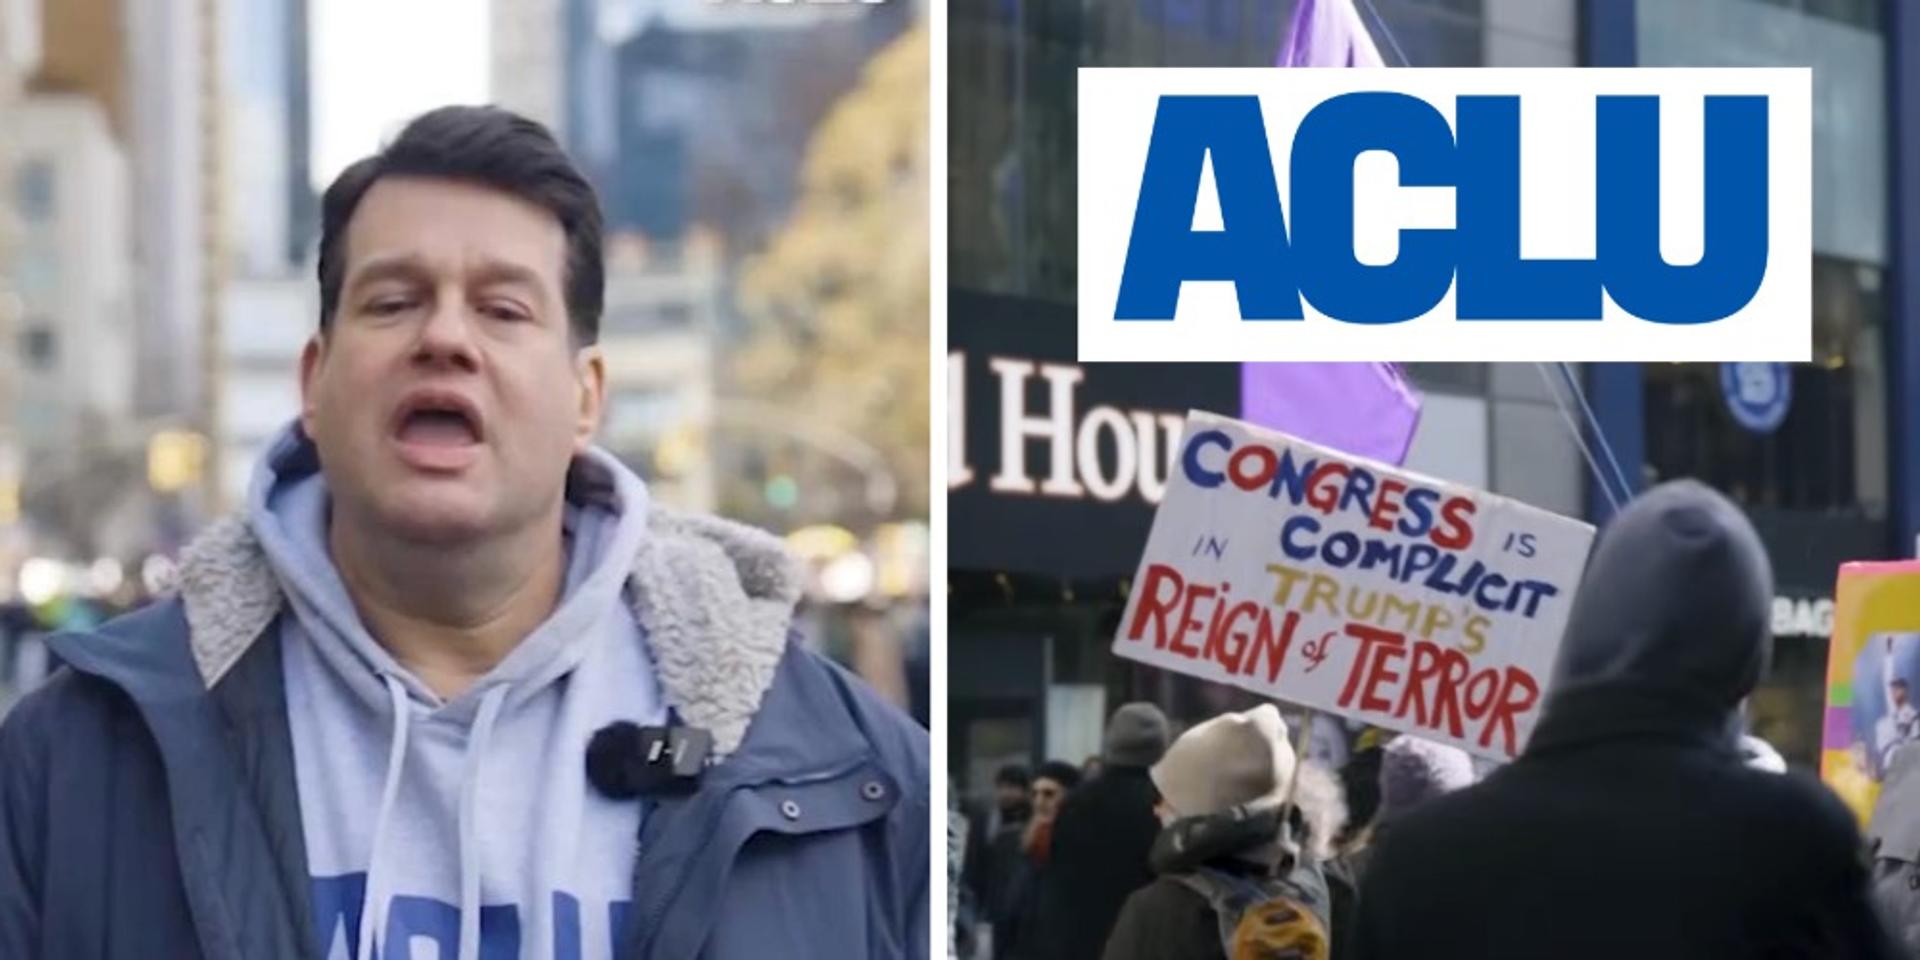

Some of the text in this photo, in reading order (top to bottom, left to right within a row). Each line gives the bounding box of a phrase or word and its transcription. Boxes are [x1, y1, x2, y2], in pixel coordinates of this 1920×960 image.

[1182, 430, 1537, 559] CONGRESS IS
[1192, 535, 1492, 656] IN TRUMP'S
[1280, 515, 1558, 618] COMPLICIT
[1302, 630, 1337, 673] of
[1337, 622, 1540, 761] TERROR
